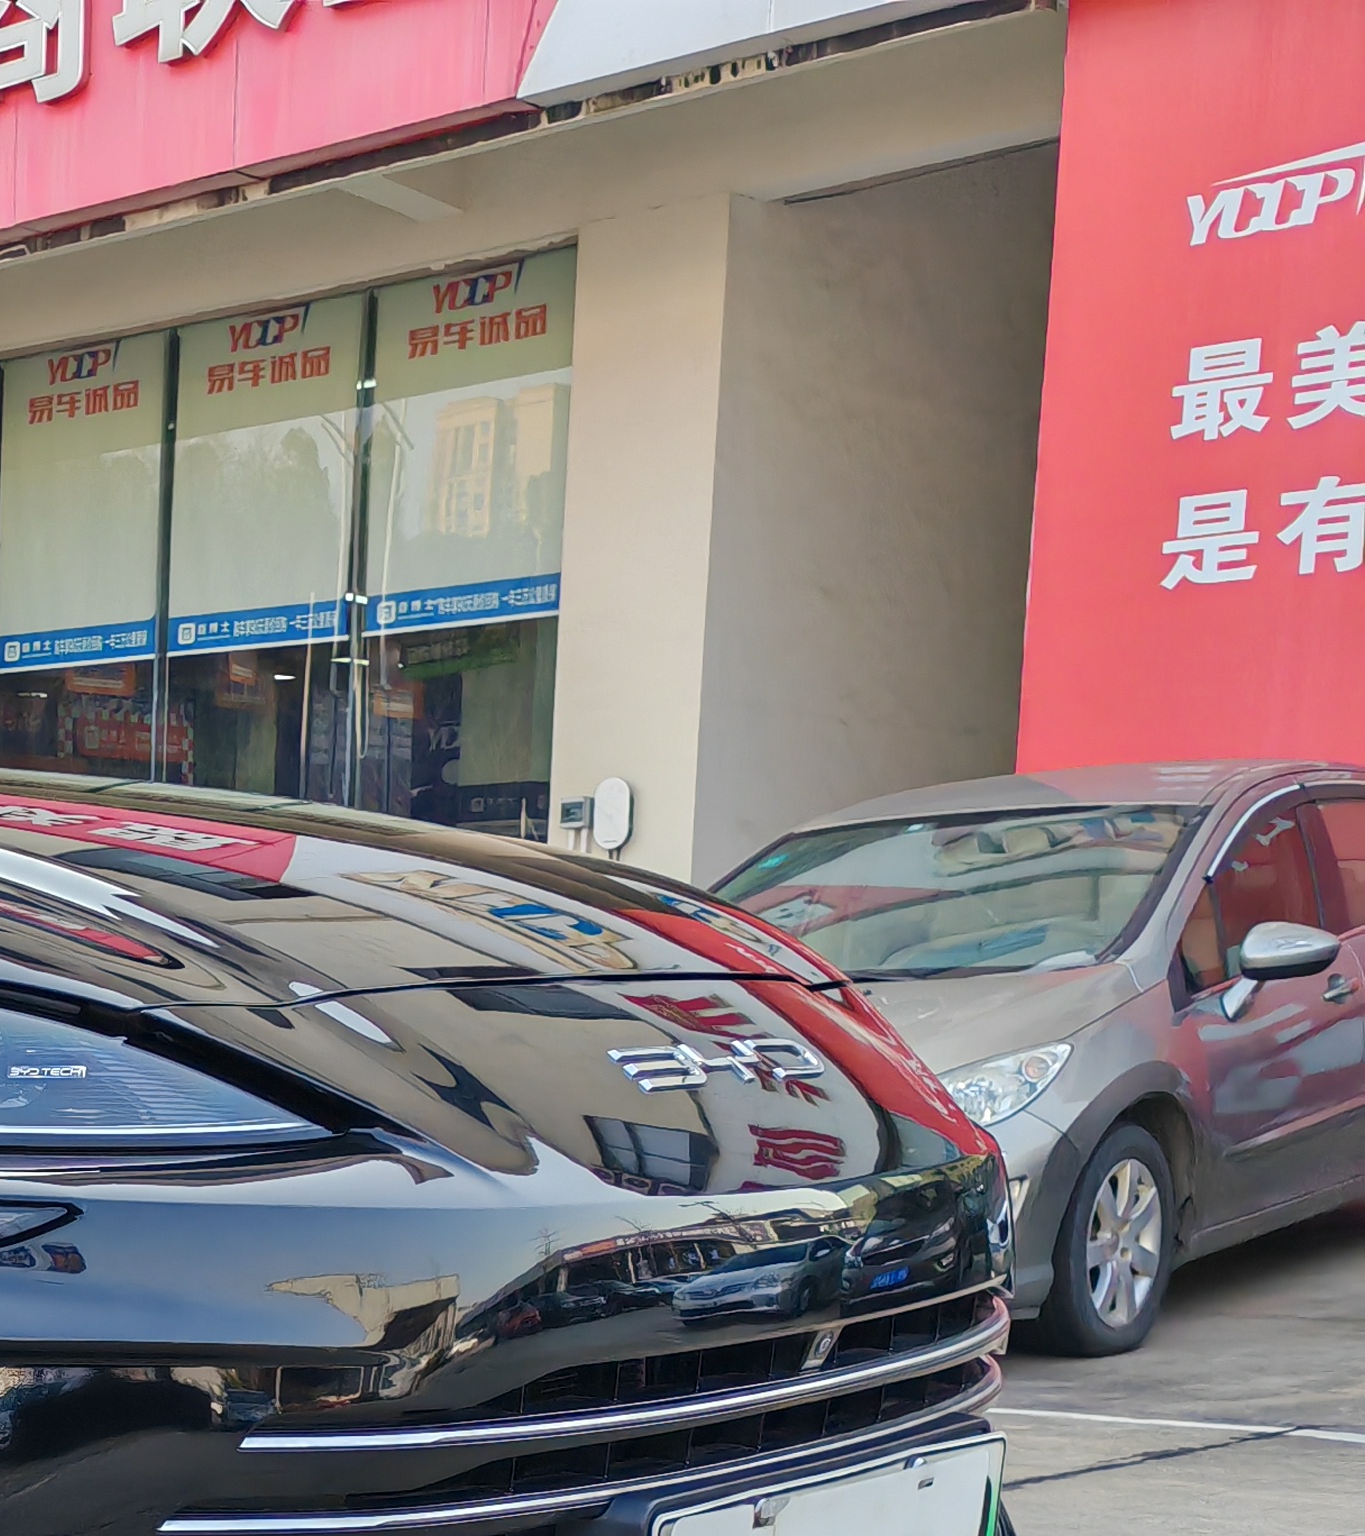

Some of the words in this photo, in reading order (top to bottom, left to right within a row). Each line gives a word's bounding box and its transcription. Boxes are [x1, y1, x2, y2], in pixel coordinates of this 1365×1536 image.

[408, 303, 547, 359] 易车诚品
[207, 346, 331, 394] 易车诚品
[1170, 321, 1365, 440] 最美
[29, 380, 139, 424] 易车诚品
[1160, 476, 1365, 589] 是有
